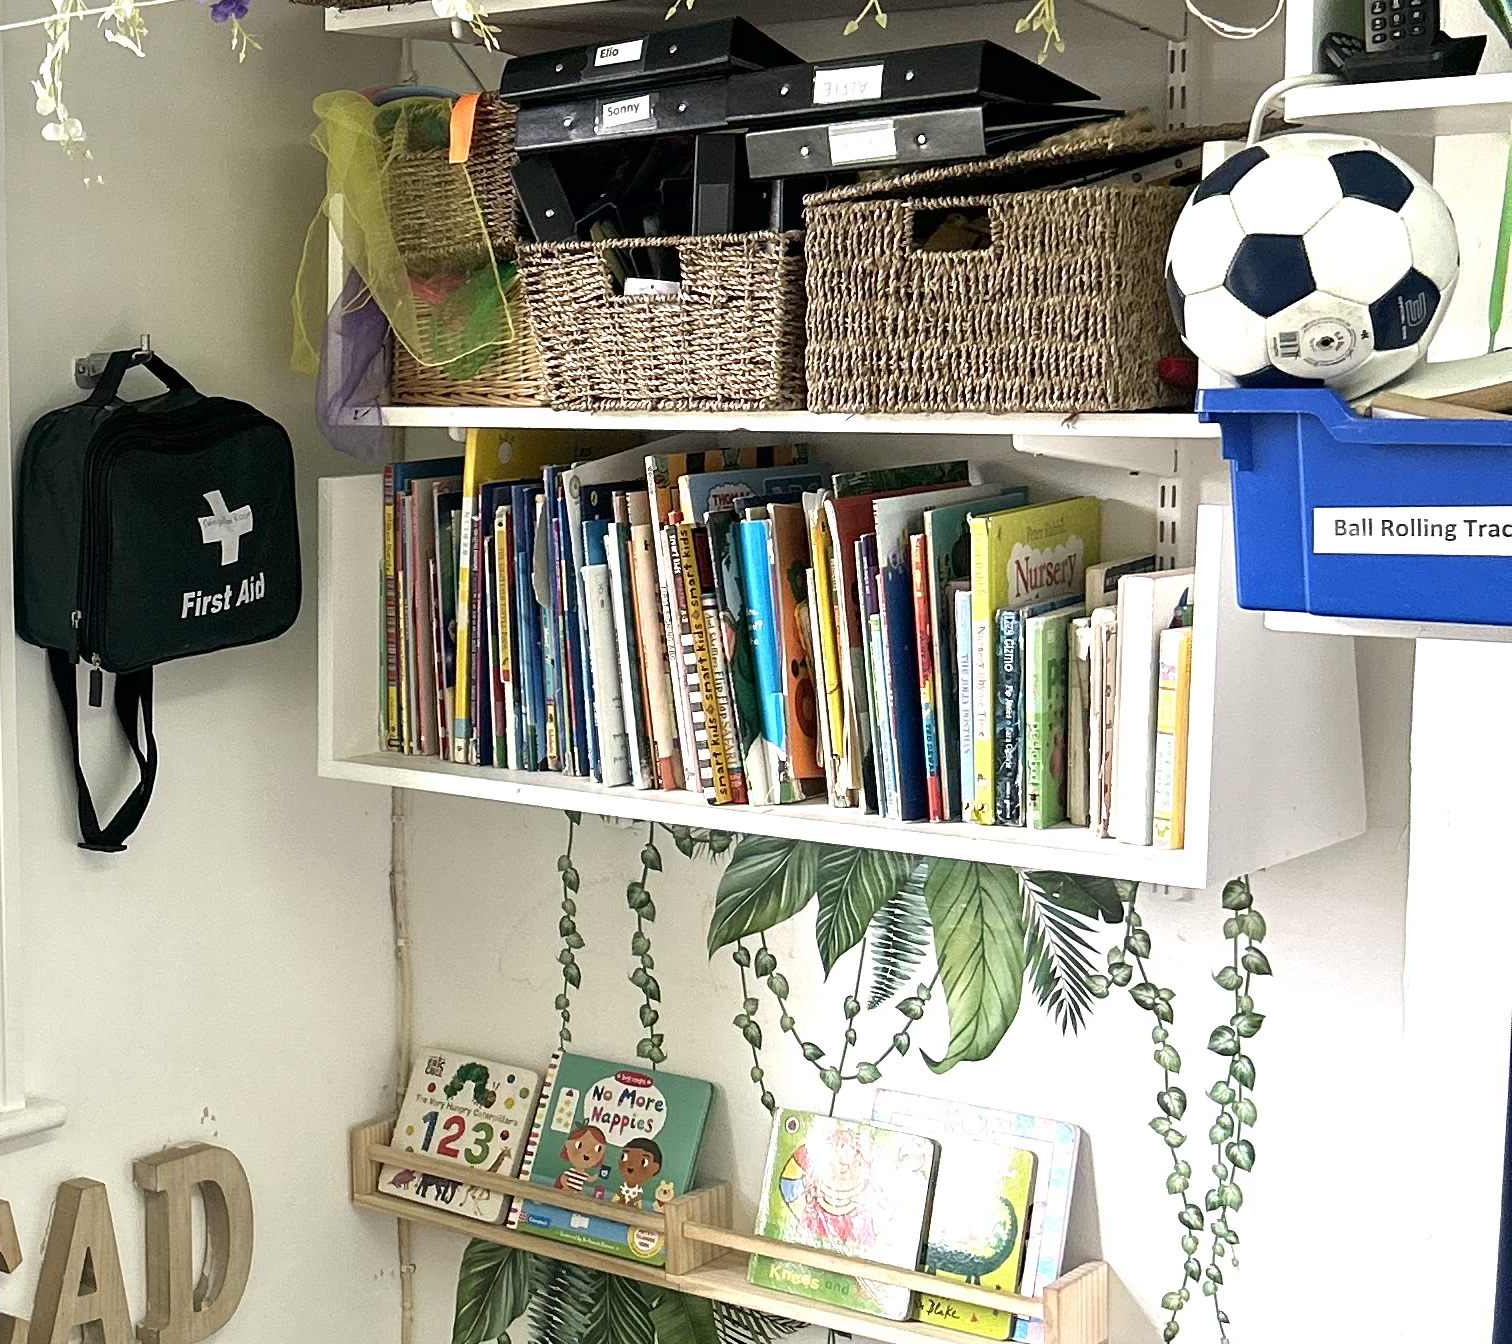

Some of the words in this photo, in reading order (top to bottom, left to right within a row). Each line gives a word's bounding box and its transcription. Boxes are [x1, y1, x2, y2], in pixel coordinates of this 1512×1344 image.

[607, 103, 641, 117] Sonny
[679, 529, 691, 557] kids
[1334, 517, 1373, 537] Ball
[1381, 518, 1457, 542] Rolling
[683, 563, 700, 607] smart
[1014, 552, 1077, 598] Nursery
[180, 584, 233, 619] First
[235, 571, 265, 607] Aid
[692, 621, 708, 653] kids
[698, 655, 715, 701] smart
[707, 717, 721, 748] kids
[712, 753, 729, 796] smart
[592, 1085, 613, 1101] No
[617, 1087, 664, 1112] More
[591, 1105, 654, 1136] Nappies
[769, 1263, 820, 1291] Knees
[824, 1279, 851, 1296] and
[927, 1298, 961, 1321] Blake
